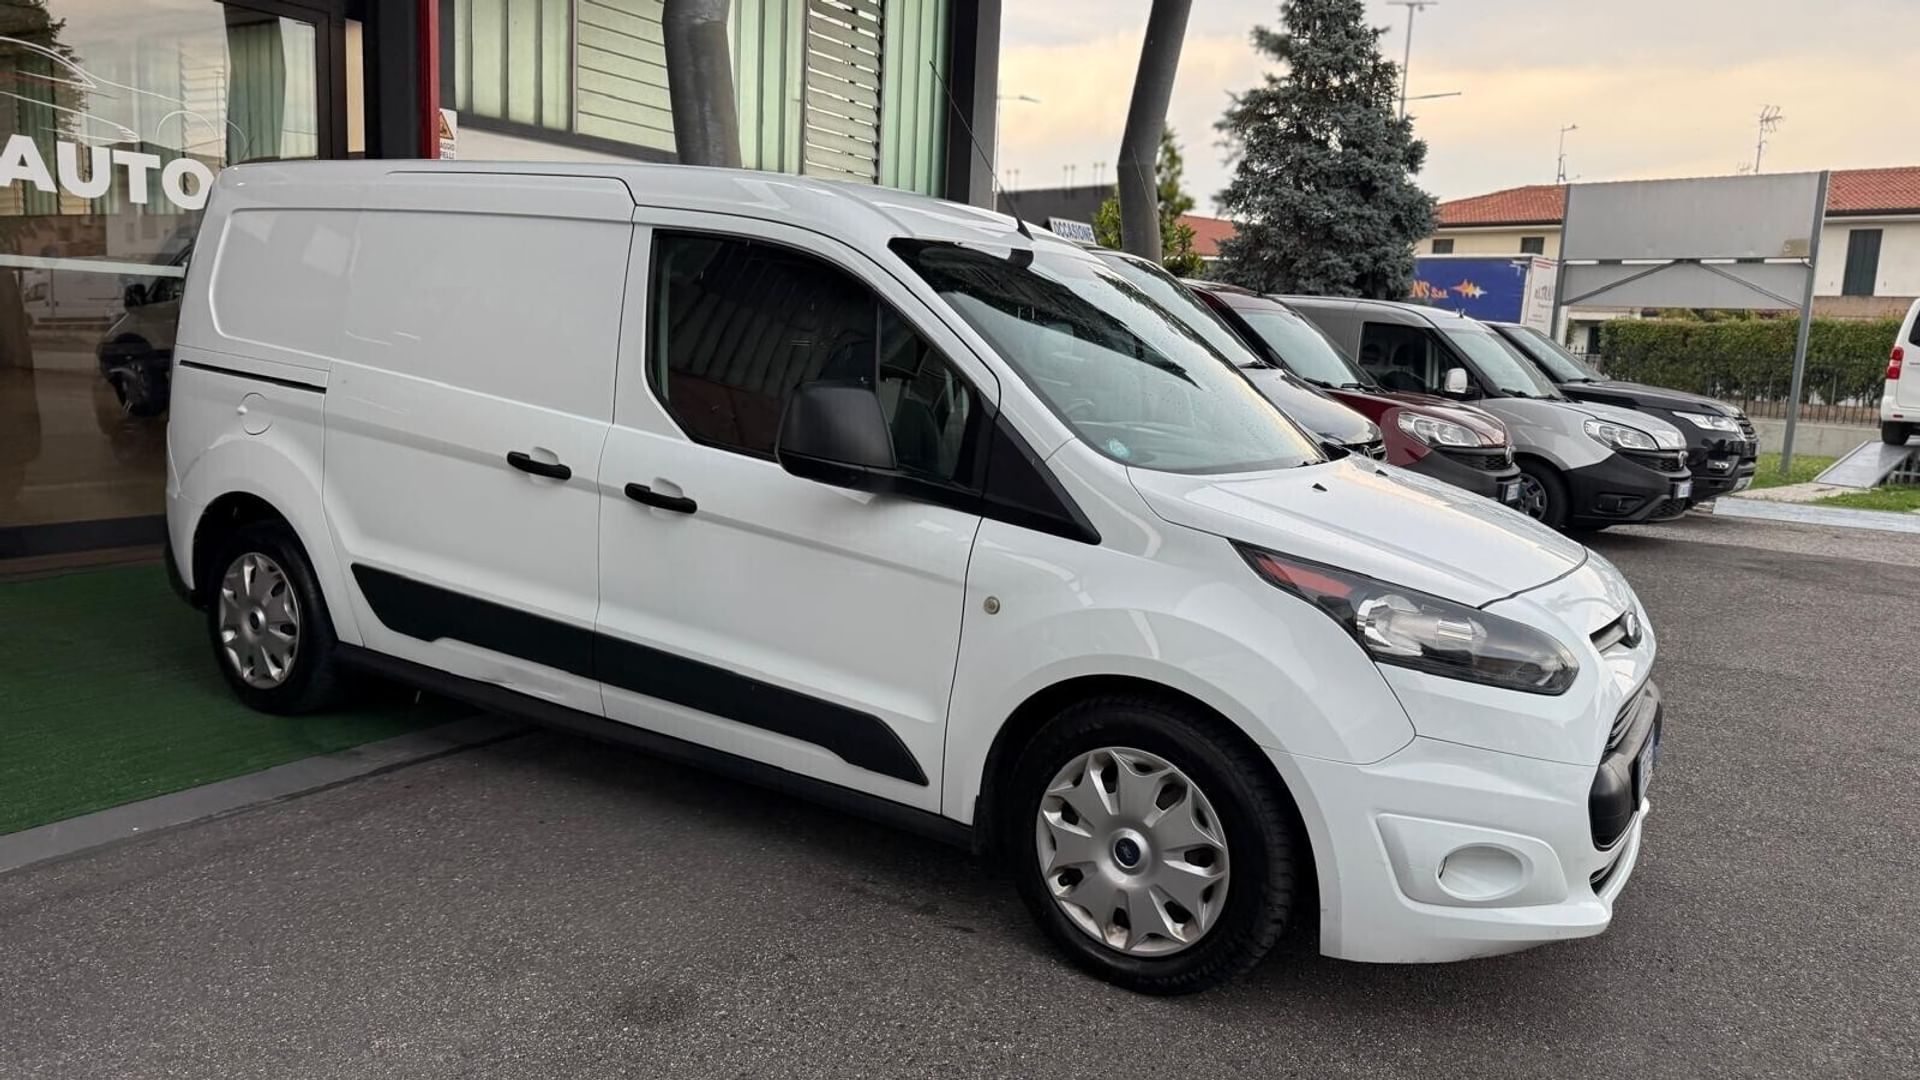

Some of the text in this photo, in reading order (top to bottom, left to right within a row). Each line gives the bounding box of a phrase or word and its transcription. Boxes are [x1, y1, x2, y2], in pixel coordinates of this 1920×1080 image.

[0, 134, 214, 210] AUTO
[1053, 221, 1094, 242] OCCASIONE
[1410, 279, 1430, 299] NS
